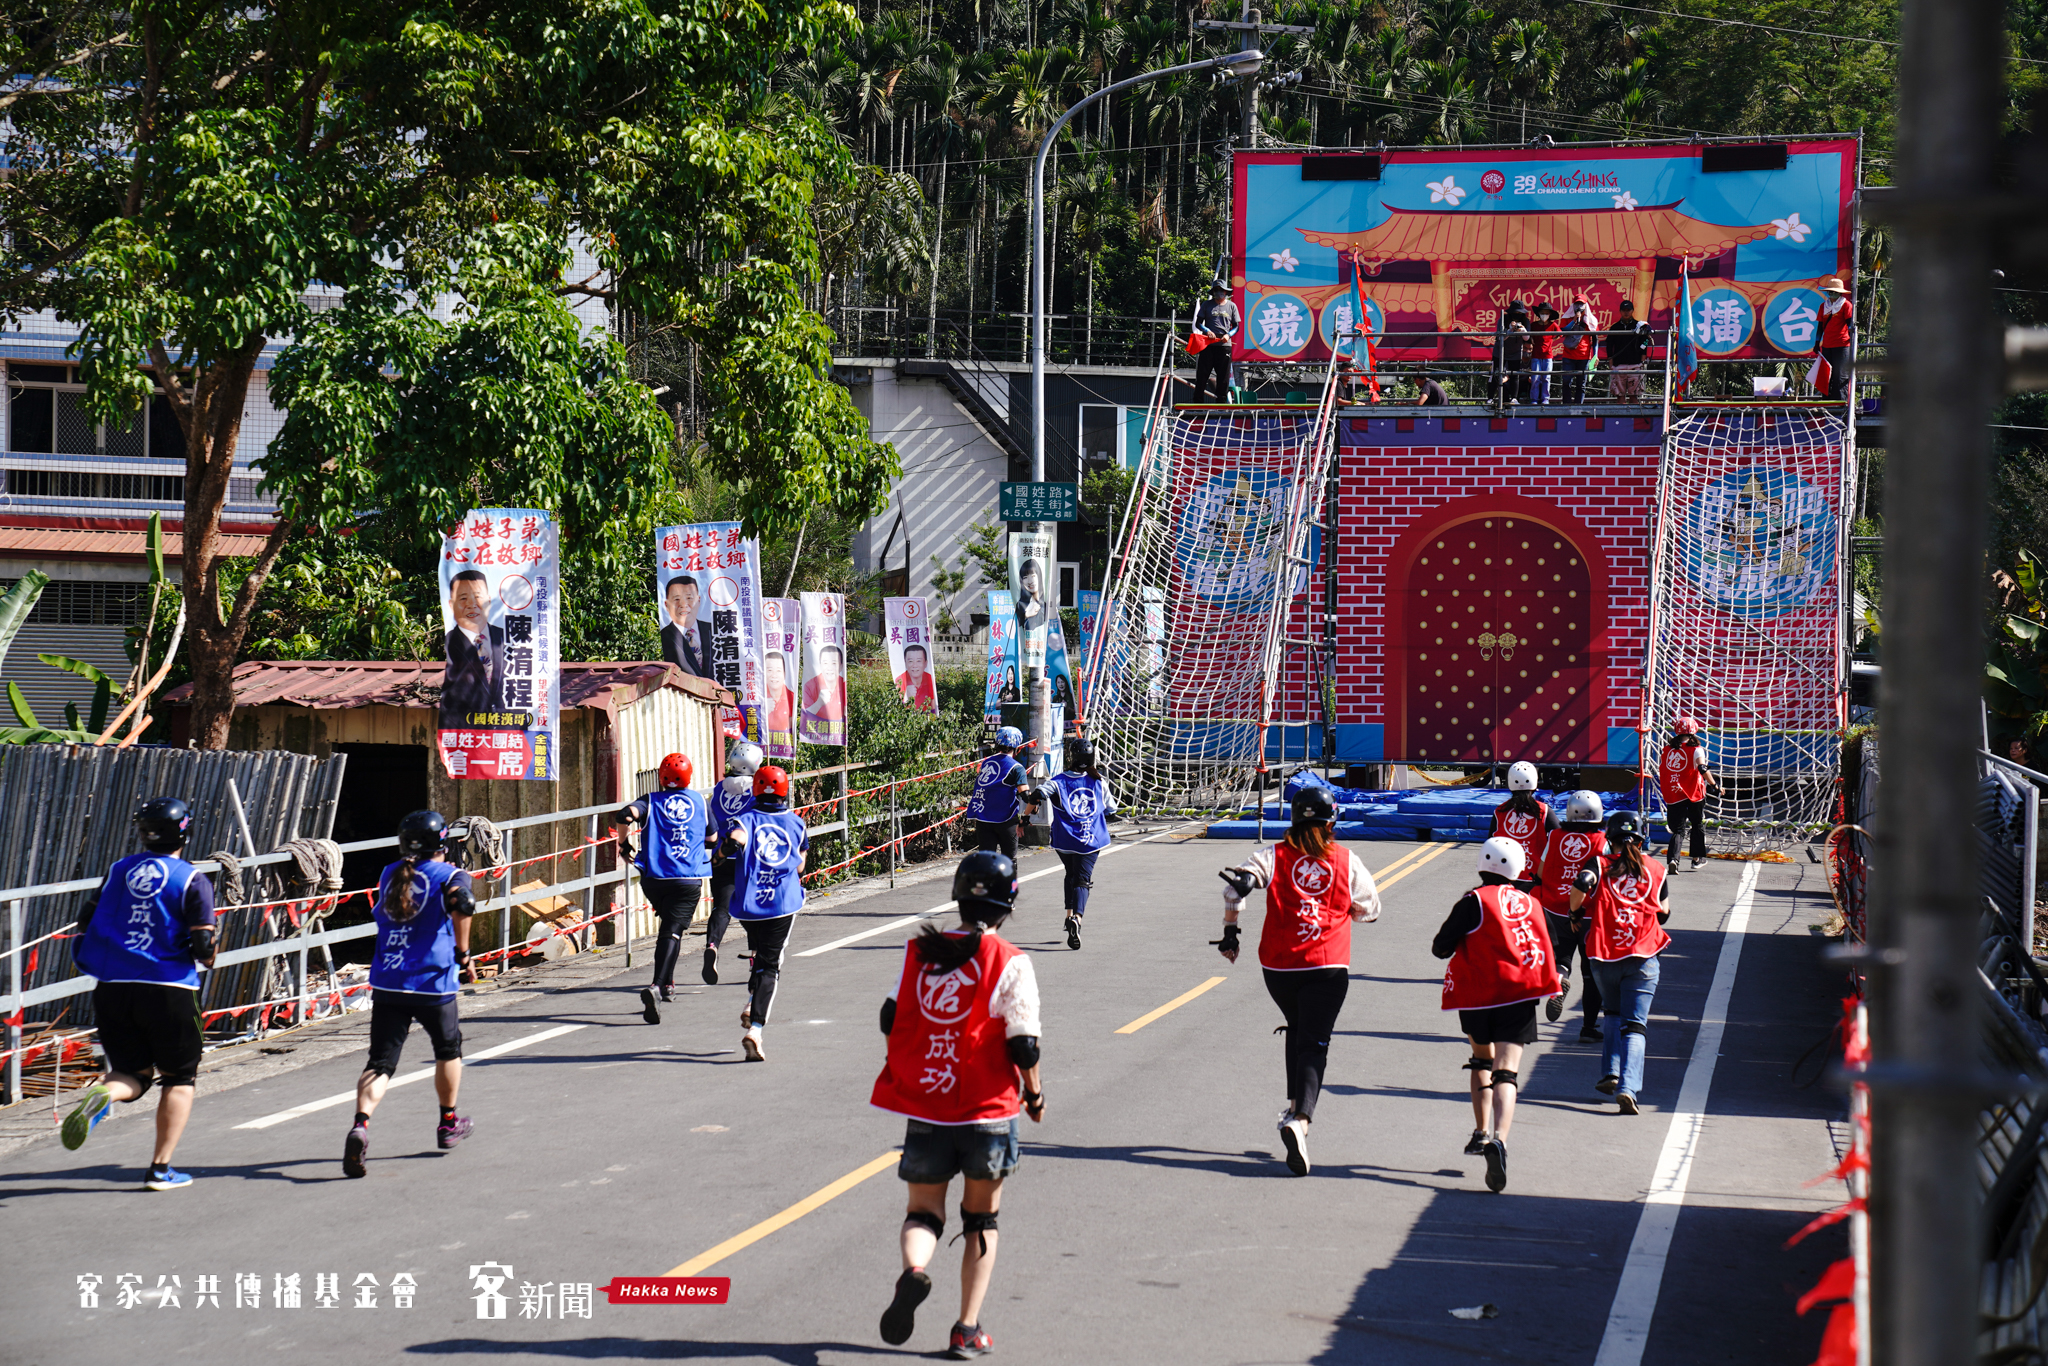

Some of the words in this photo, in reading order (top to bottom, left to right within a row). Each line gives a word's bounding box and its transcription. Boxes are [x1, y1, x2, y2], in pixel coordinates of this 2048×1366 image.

[1015, 485, 1062, 498] 國姓路
[1014, 498, 1062, 509] 民生街
[445, 542, 543, 567] 心在故鄉
[662, 550, 747, 572] 心在故鄉
[740, 576, 754, 658] 南投縣議員候選人
[768, 606, 776, 618] 3
[823, 600, 833, 614] 3
[908, 604, 915, 614] 3
[535, 576, 549, 675] 南投縣議員候選人
[441, 732, 524, 749] 國姓大團結
[443, 750, 524, 776] 搶一席
[534, 733, 548, 778] 全職服務
[1297, 859, 1328, 943] 搶成功
